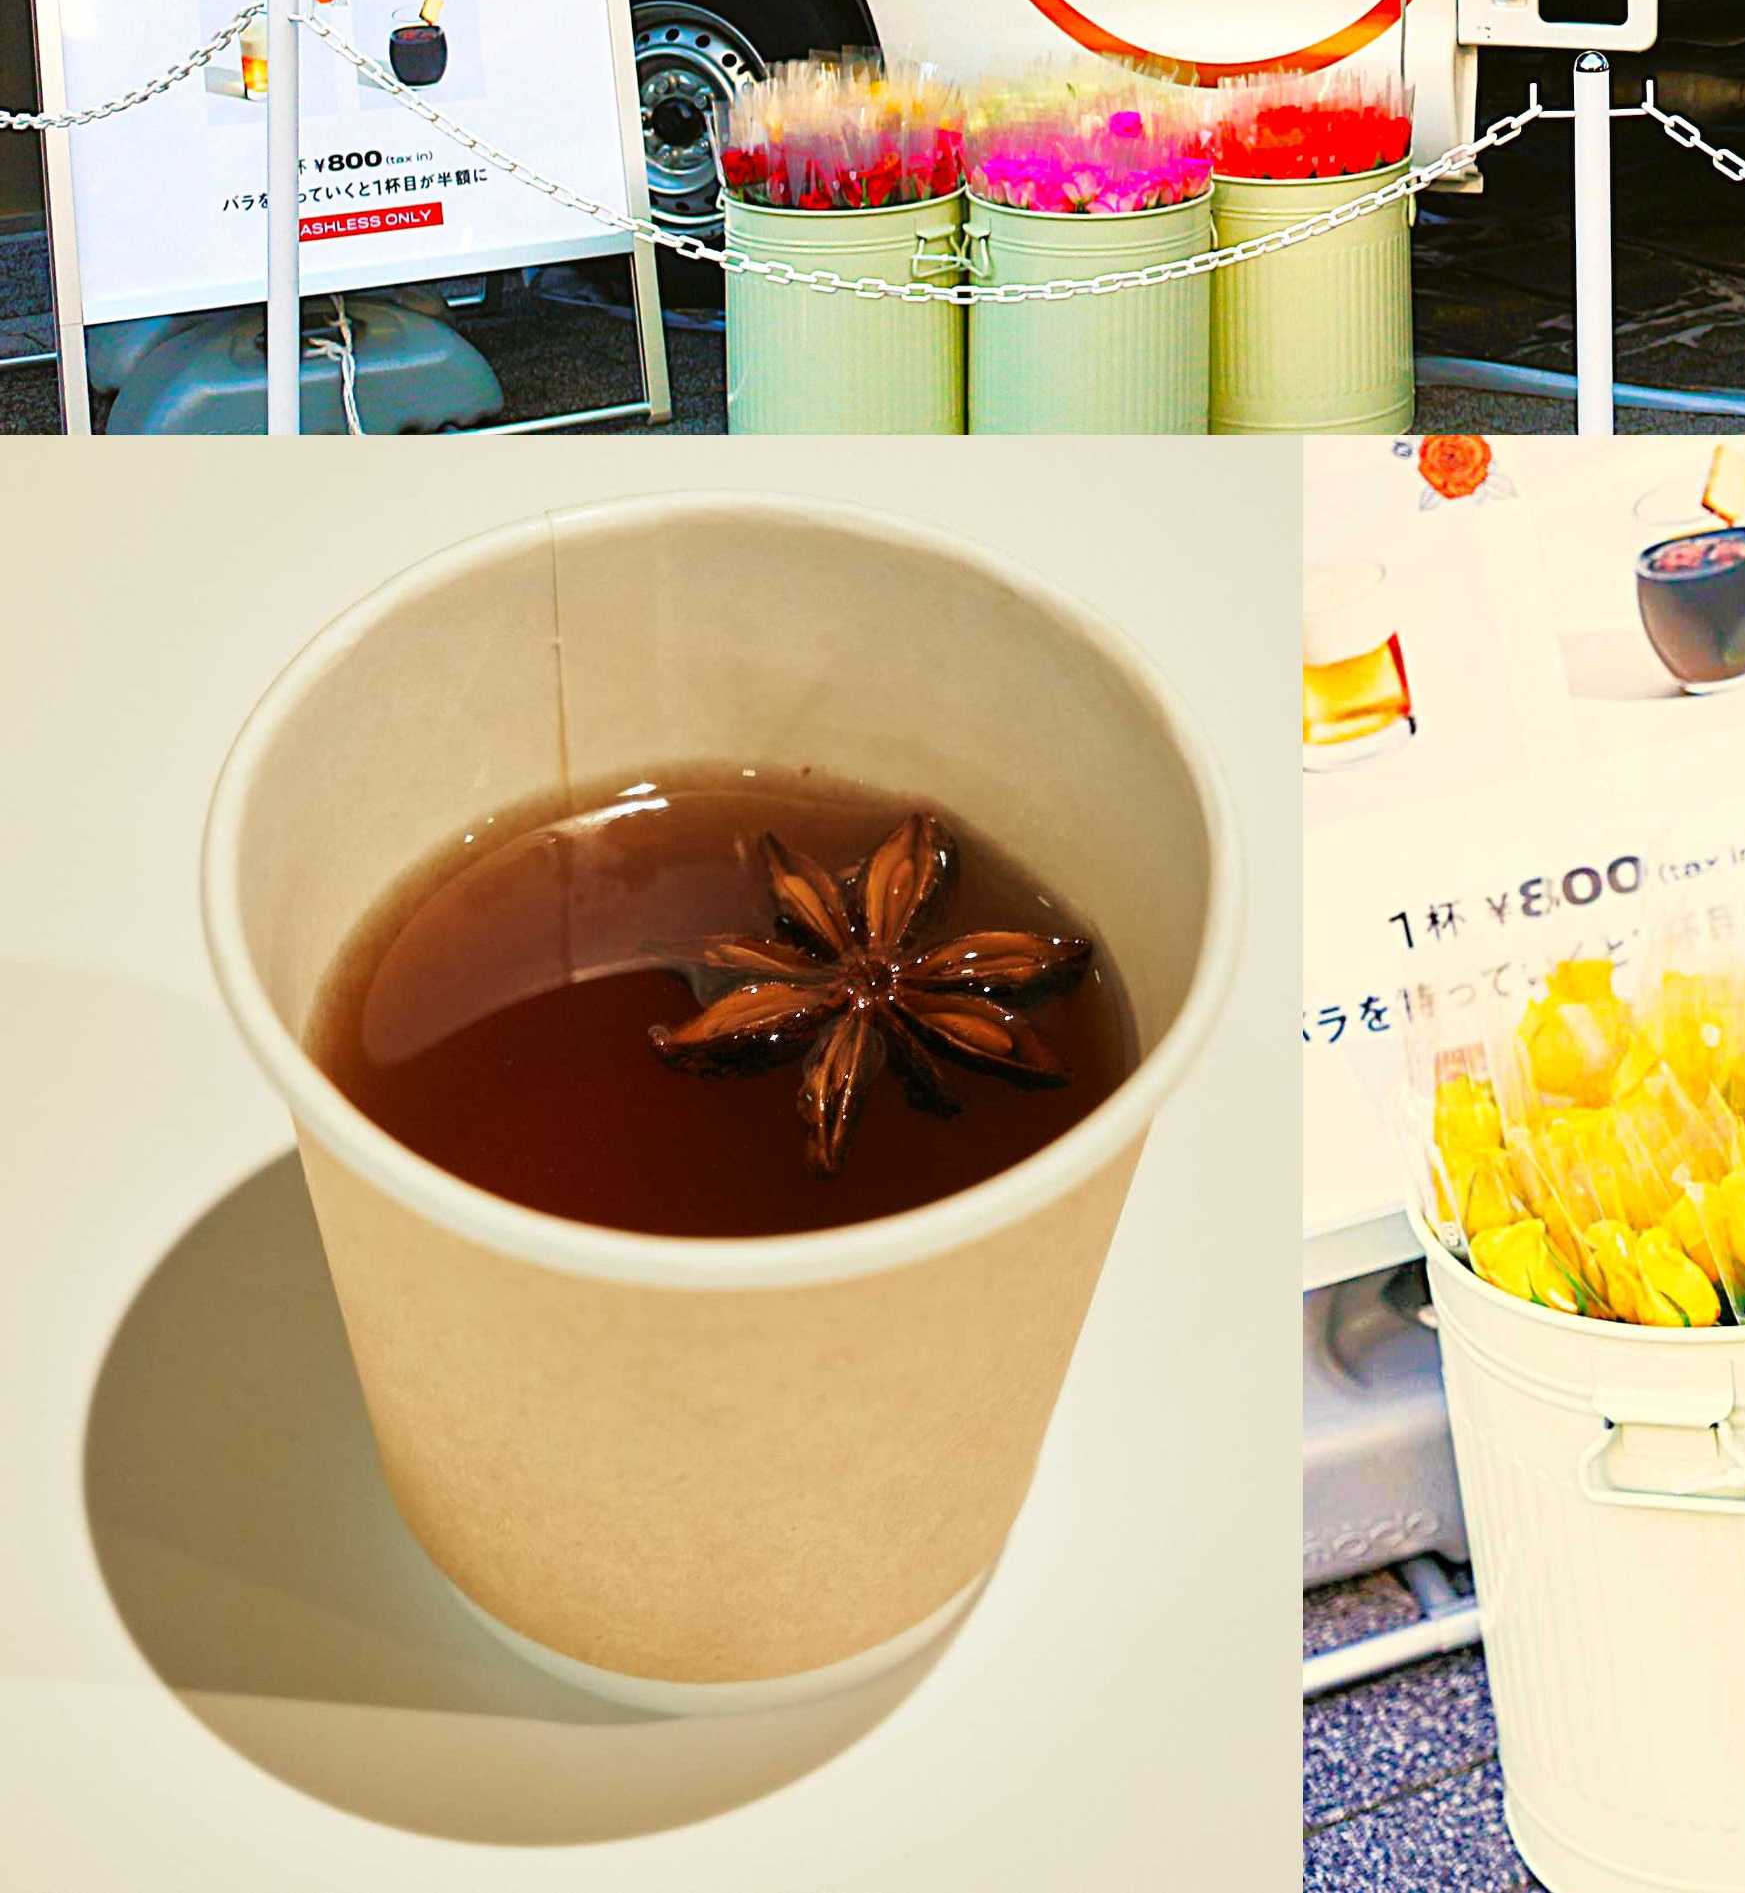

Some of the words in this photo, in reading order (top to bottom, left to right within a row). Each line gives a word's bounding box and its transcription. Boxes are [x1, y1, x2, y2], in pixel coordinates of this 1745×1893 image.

[314, 149, 383, 174] ¥800
[386, 154, 413, 166] (tax
[416, 151, 434, 163] in)
[222, 167, 489, 212] バラをっていくと1杯目が半額に
[299, 215, 382, 237] ASHLESS
[385, 209, 432, 227] ONLY
[1388, 901, 1467, 950] 1杯
[1485, 854, 1644, 926] ¥800
